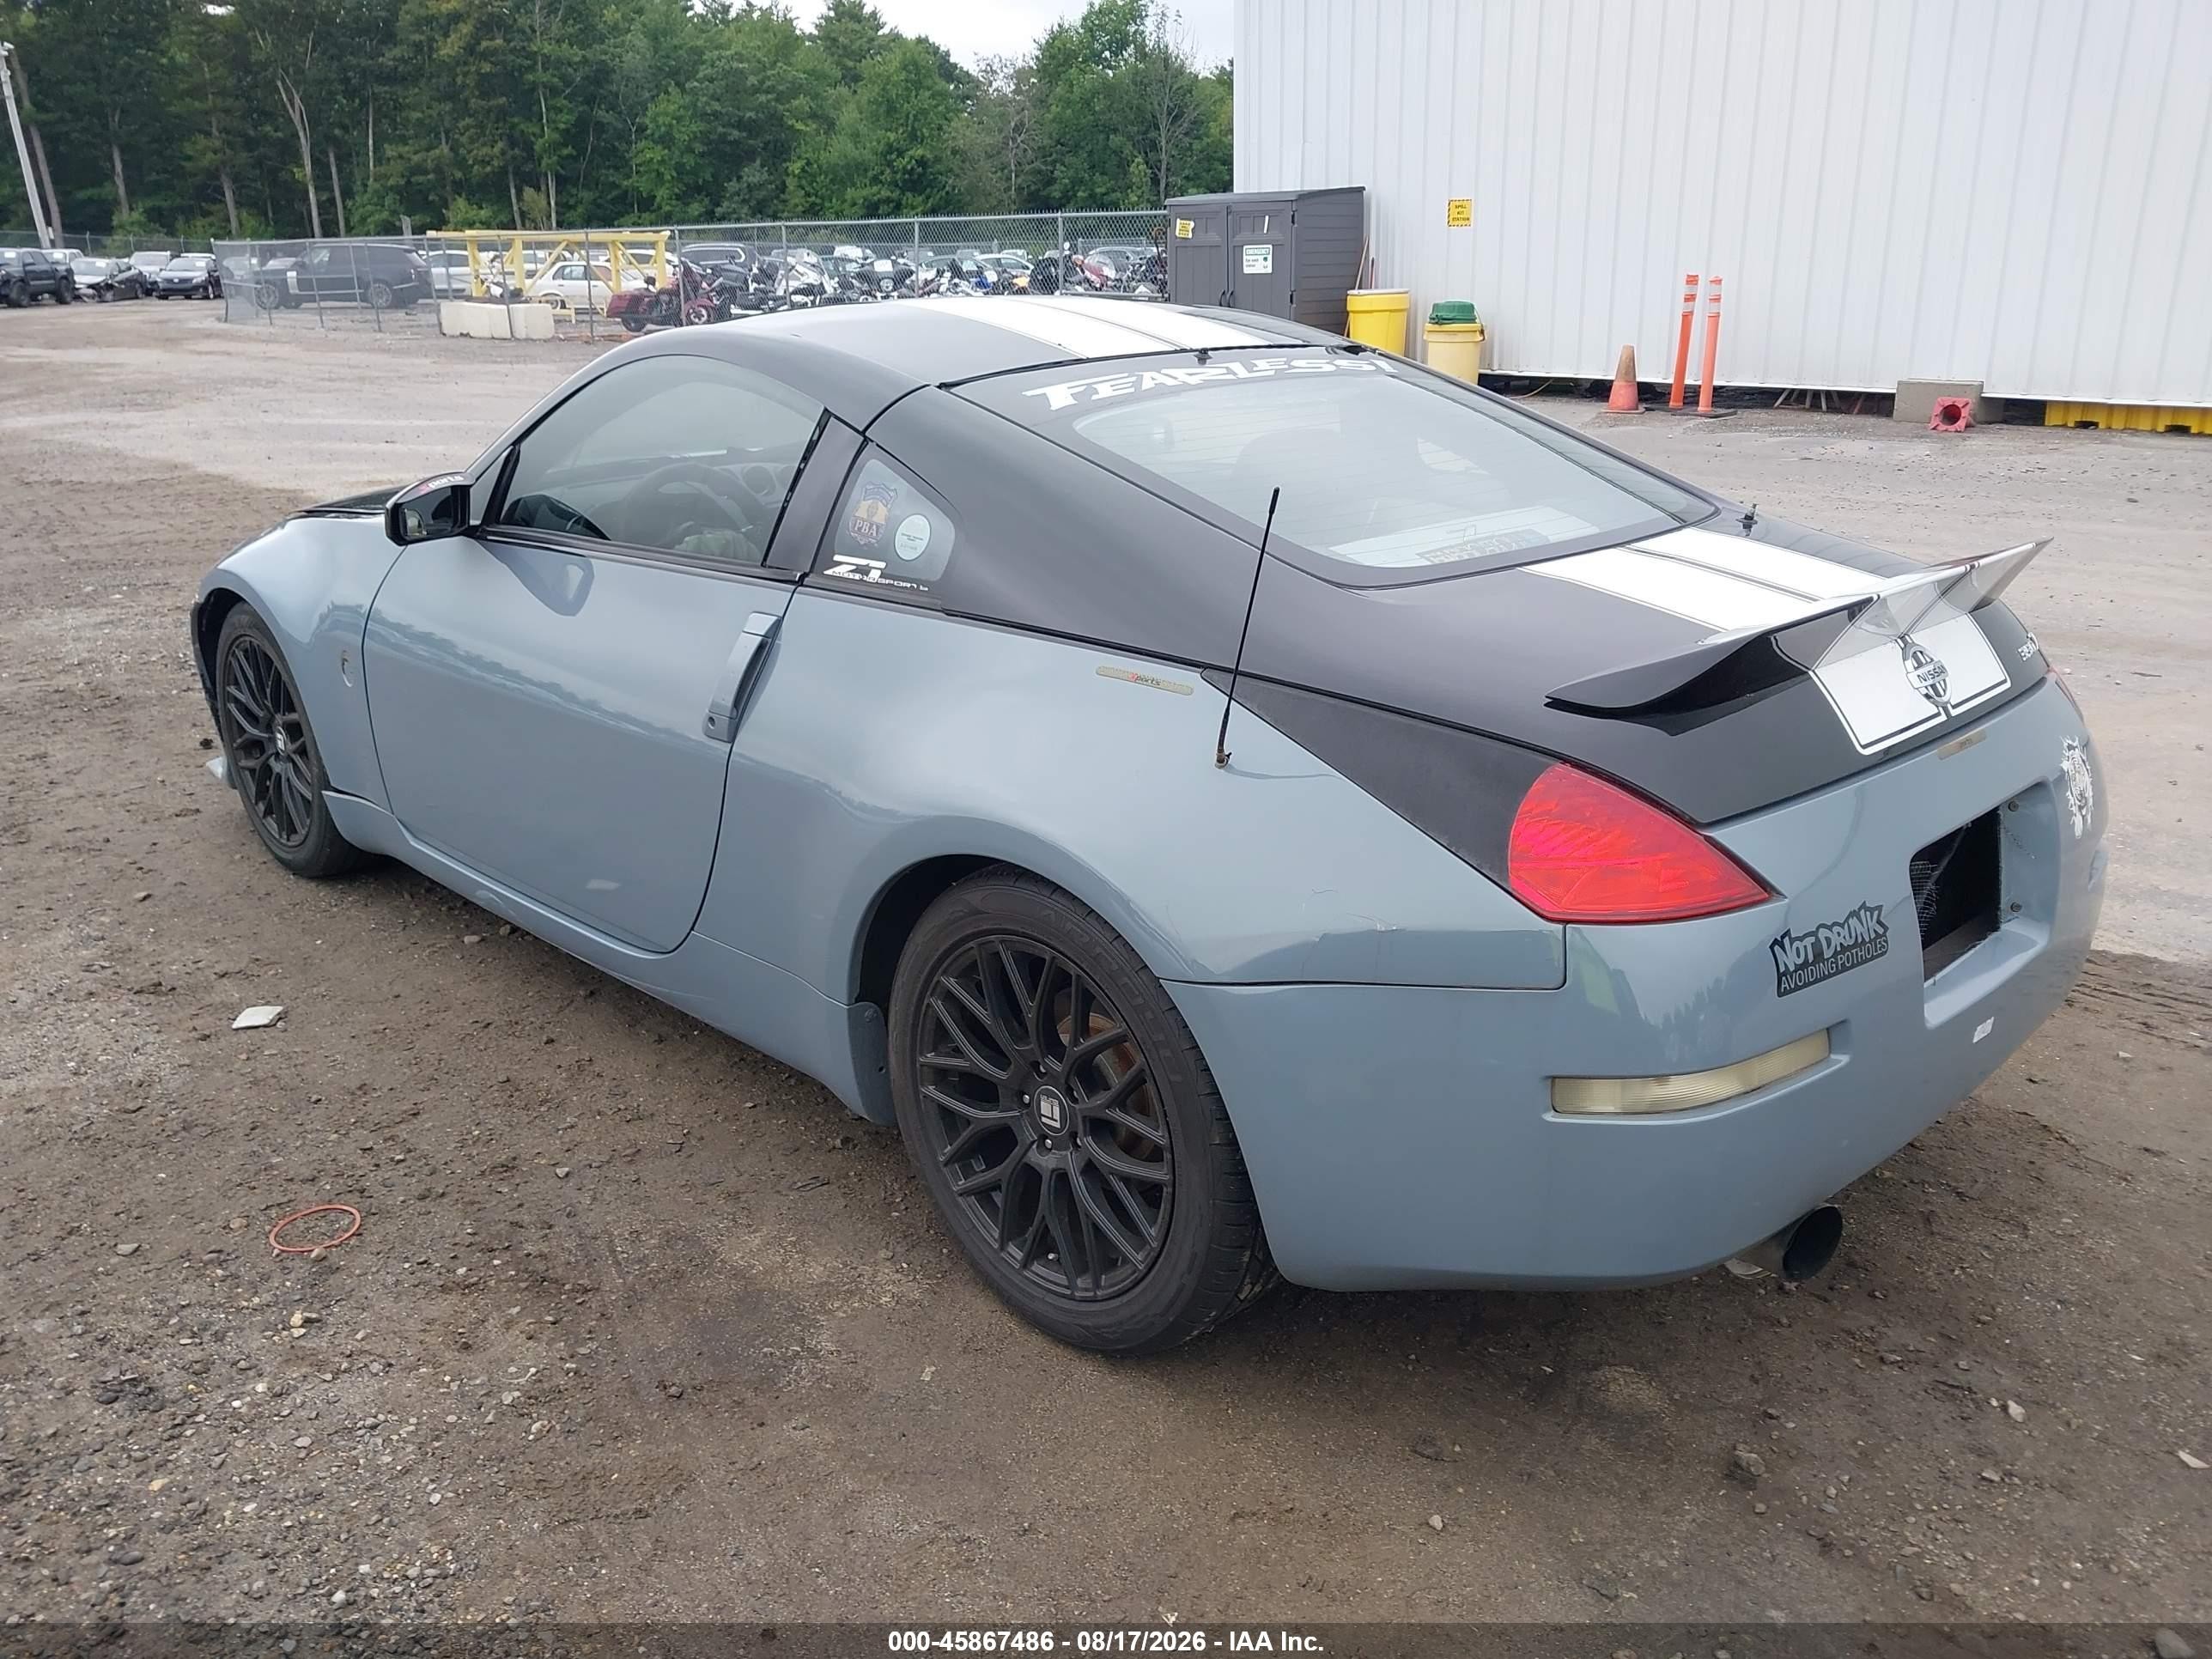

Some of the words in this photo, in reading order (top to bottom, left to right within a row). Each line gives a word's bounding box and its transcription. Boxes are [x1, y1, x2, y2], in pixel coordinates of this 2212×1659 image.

[854, 520, 877, 537] PBA
[1773, 936, 1815, 973] NOT
[1818, 909, 1885, 958] DRUNK
[1781, 958, 1836, 993] AVOIDING
[1837, 937, 1887, 970] POTHOLES
